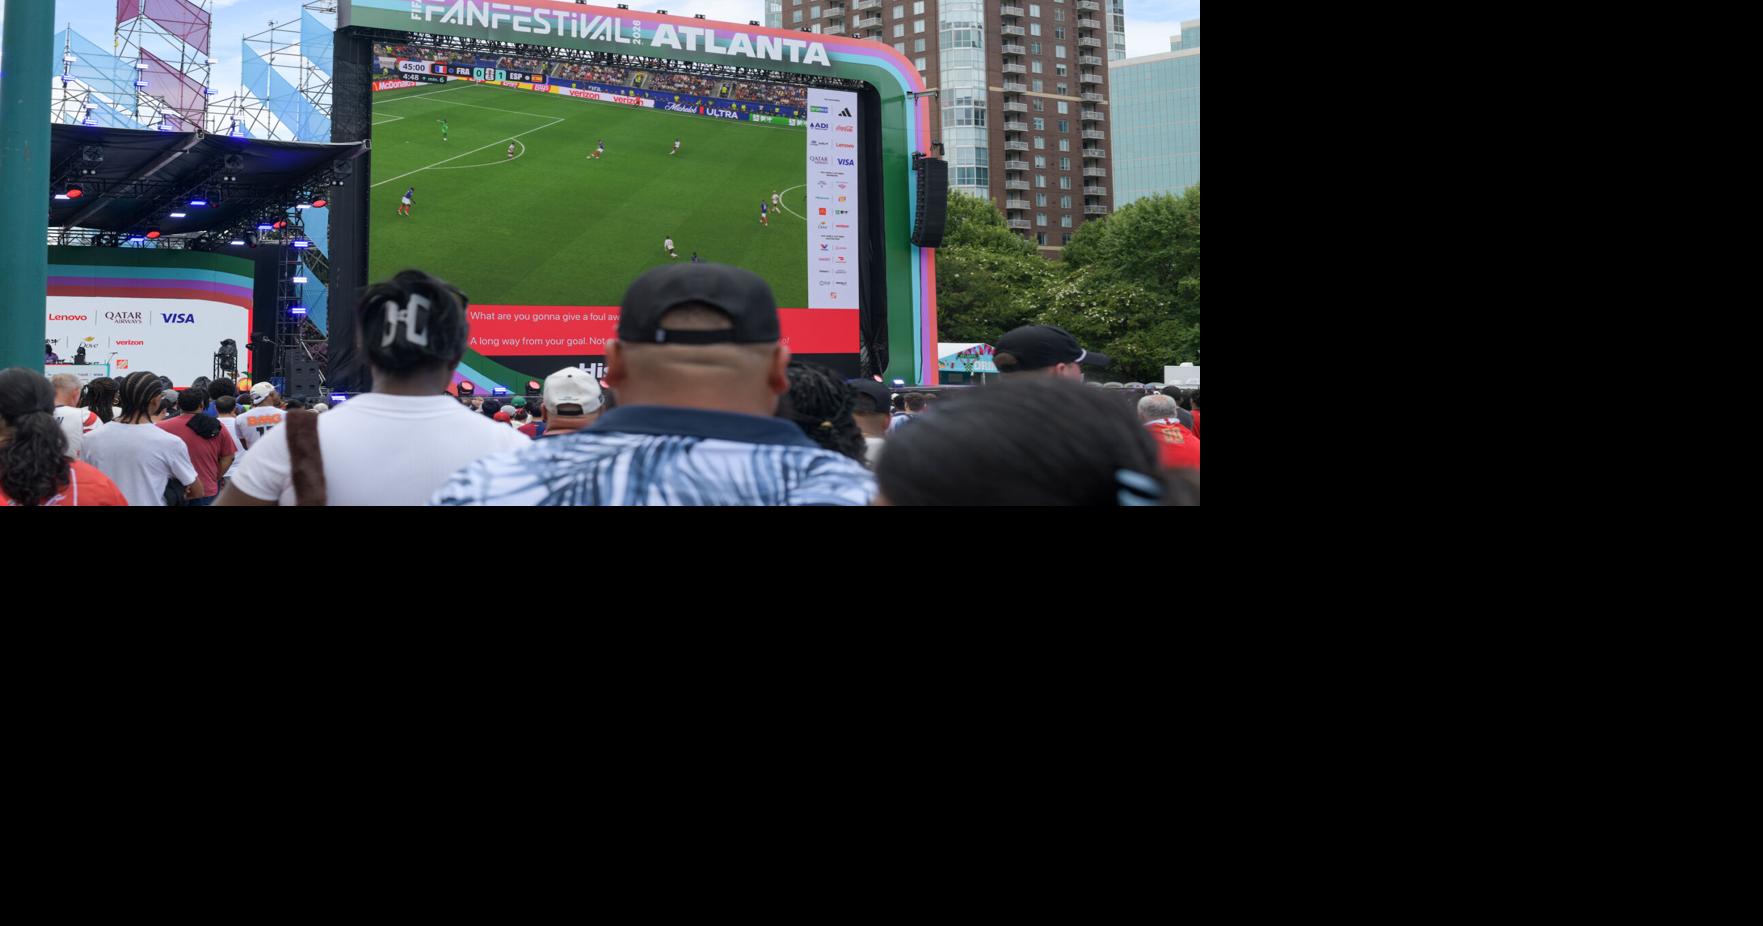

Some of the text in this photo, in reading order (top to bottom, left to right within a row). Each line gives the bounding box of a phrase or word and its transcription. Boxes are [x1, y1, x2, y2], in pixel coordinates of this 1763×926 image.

[632, 20, 642, 45] 2026
[650, 23, 831, 67] ATLANTA
[402, 63, 426, 72] 45:00
[456, 67, 470, 75] FRA
[476, 69, 482, 77] 0
[509, 72, 523, 80] ESP
[402, 73, 420, 81] 4:48
[569, 89, 600, 100] verizon
[706, 107, 739, 119] ULTRA
[837, 158, 855, 166] VISA
[48, 313, 88, 321] Lenovo
[104, 311, 142, 320] QATAR
[161, 313, 195, 324] VISA
[470, 311, 495, 321] What
[514, 313, 530, 322] you
[532, 313, 561, 322] gonna
[562, 313, 581, 322] give
[590, 312, 606, 321] foul
[470, 336, 478, 345] A
[479, 336, 500, 347] long
[501, 339, 520, 348] way
[522, 336, 544, 345] from
[545, 338, 564, 347] your
[566, 336, 587, 347] goal.
